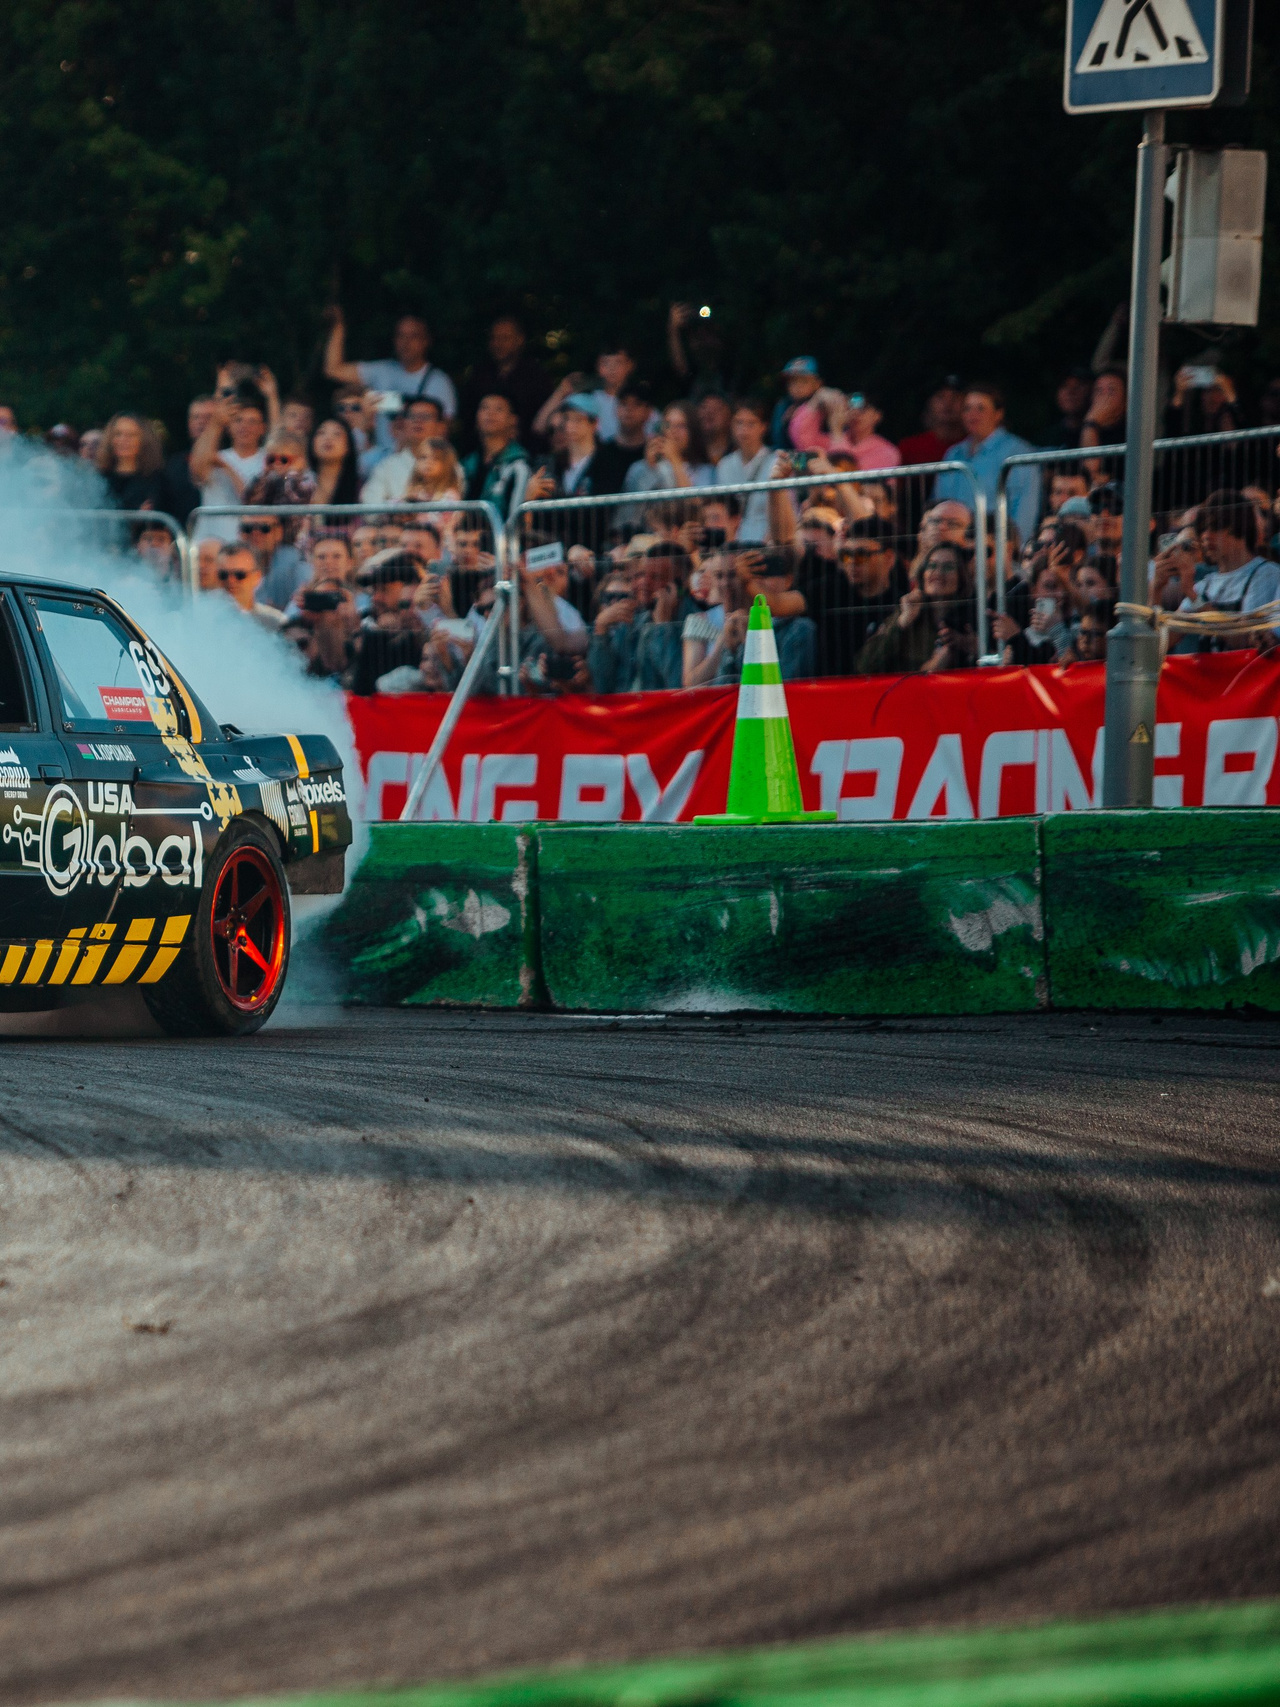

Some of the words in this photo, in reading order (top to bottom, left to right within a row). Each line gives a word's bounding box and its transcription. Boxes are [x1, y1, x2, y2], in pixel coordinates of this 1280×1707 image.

[128, 639, 171, 696] 69
[103, 695, 147, 707] CHAMPION
[87, 781, 133, 815] USA
[44, 797, 204, 889] Global
